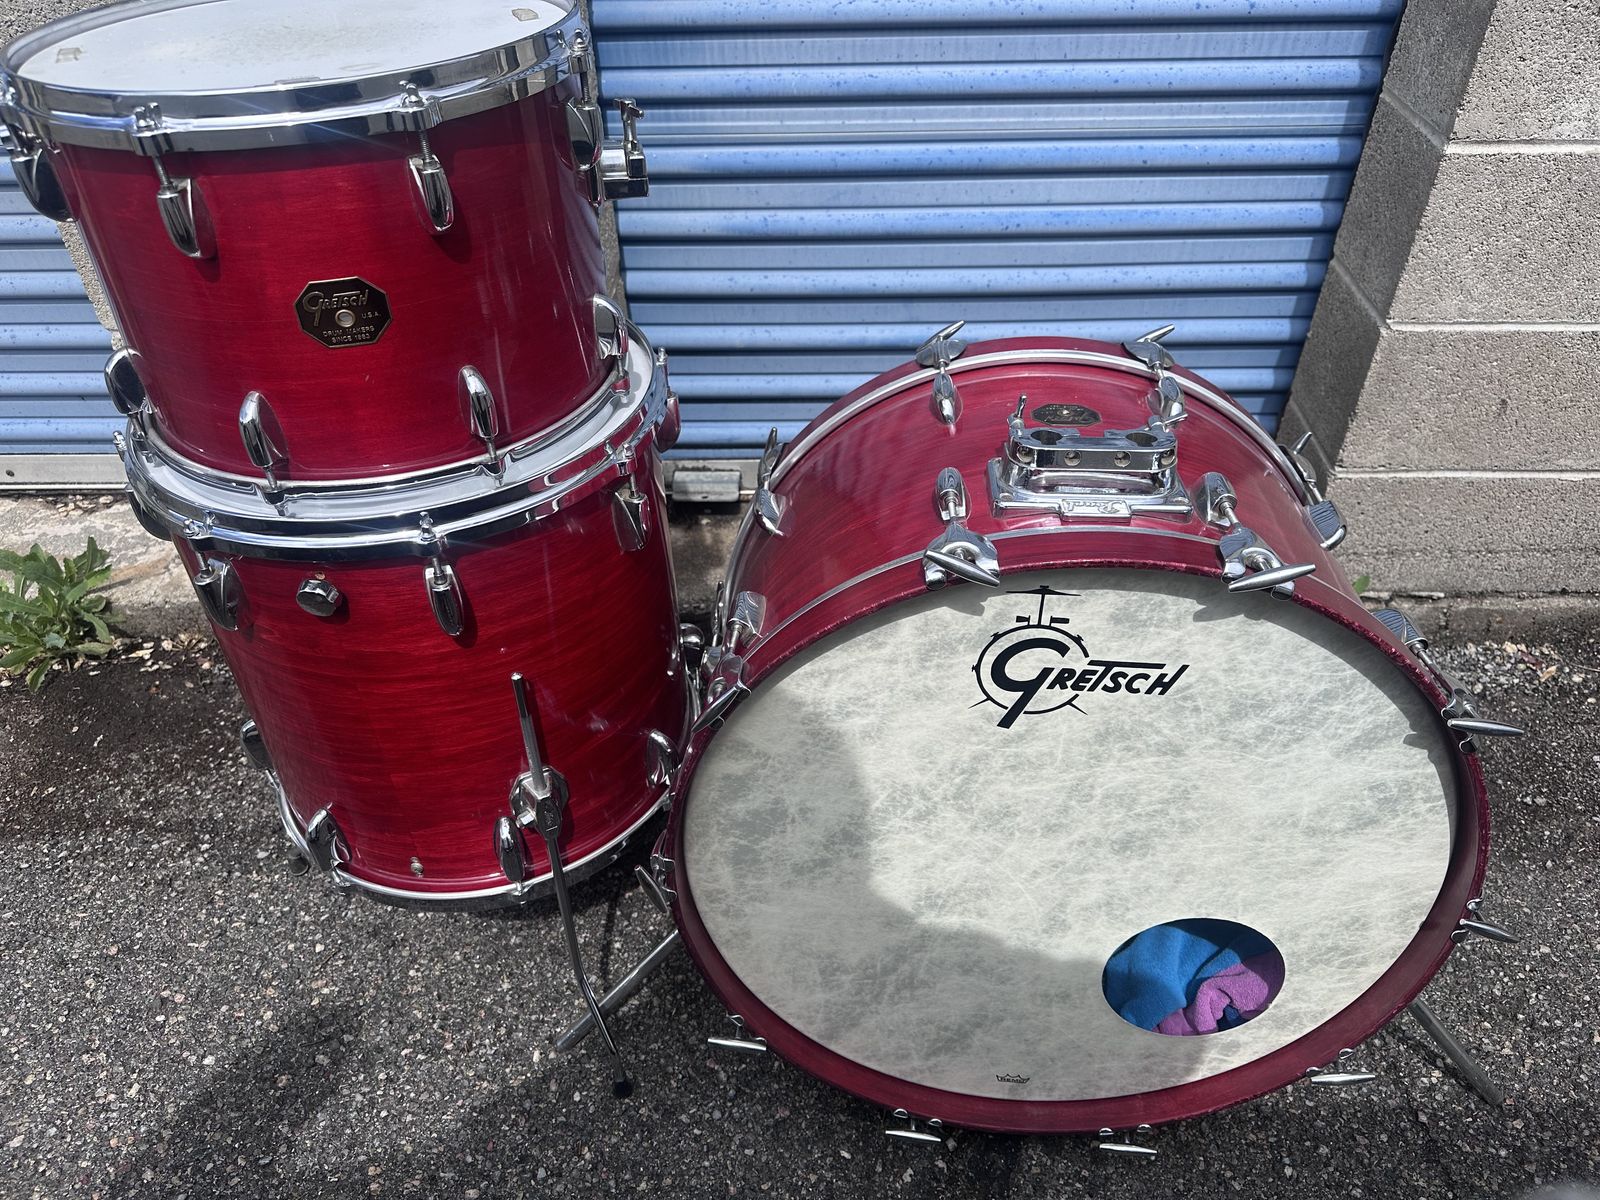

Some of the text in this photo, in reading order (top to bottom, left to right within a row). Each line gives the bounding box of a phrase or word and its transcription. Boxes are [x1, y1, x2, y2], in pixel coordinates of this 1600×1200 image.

[322, 325, 375, 338] DRUM MAKERS
[331, 335, 353, 343] SINCE
[990, 637, 1190, 729] GRETSCH
